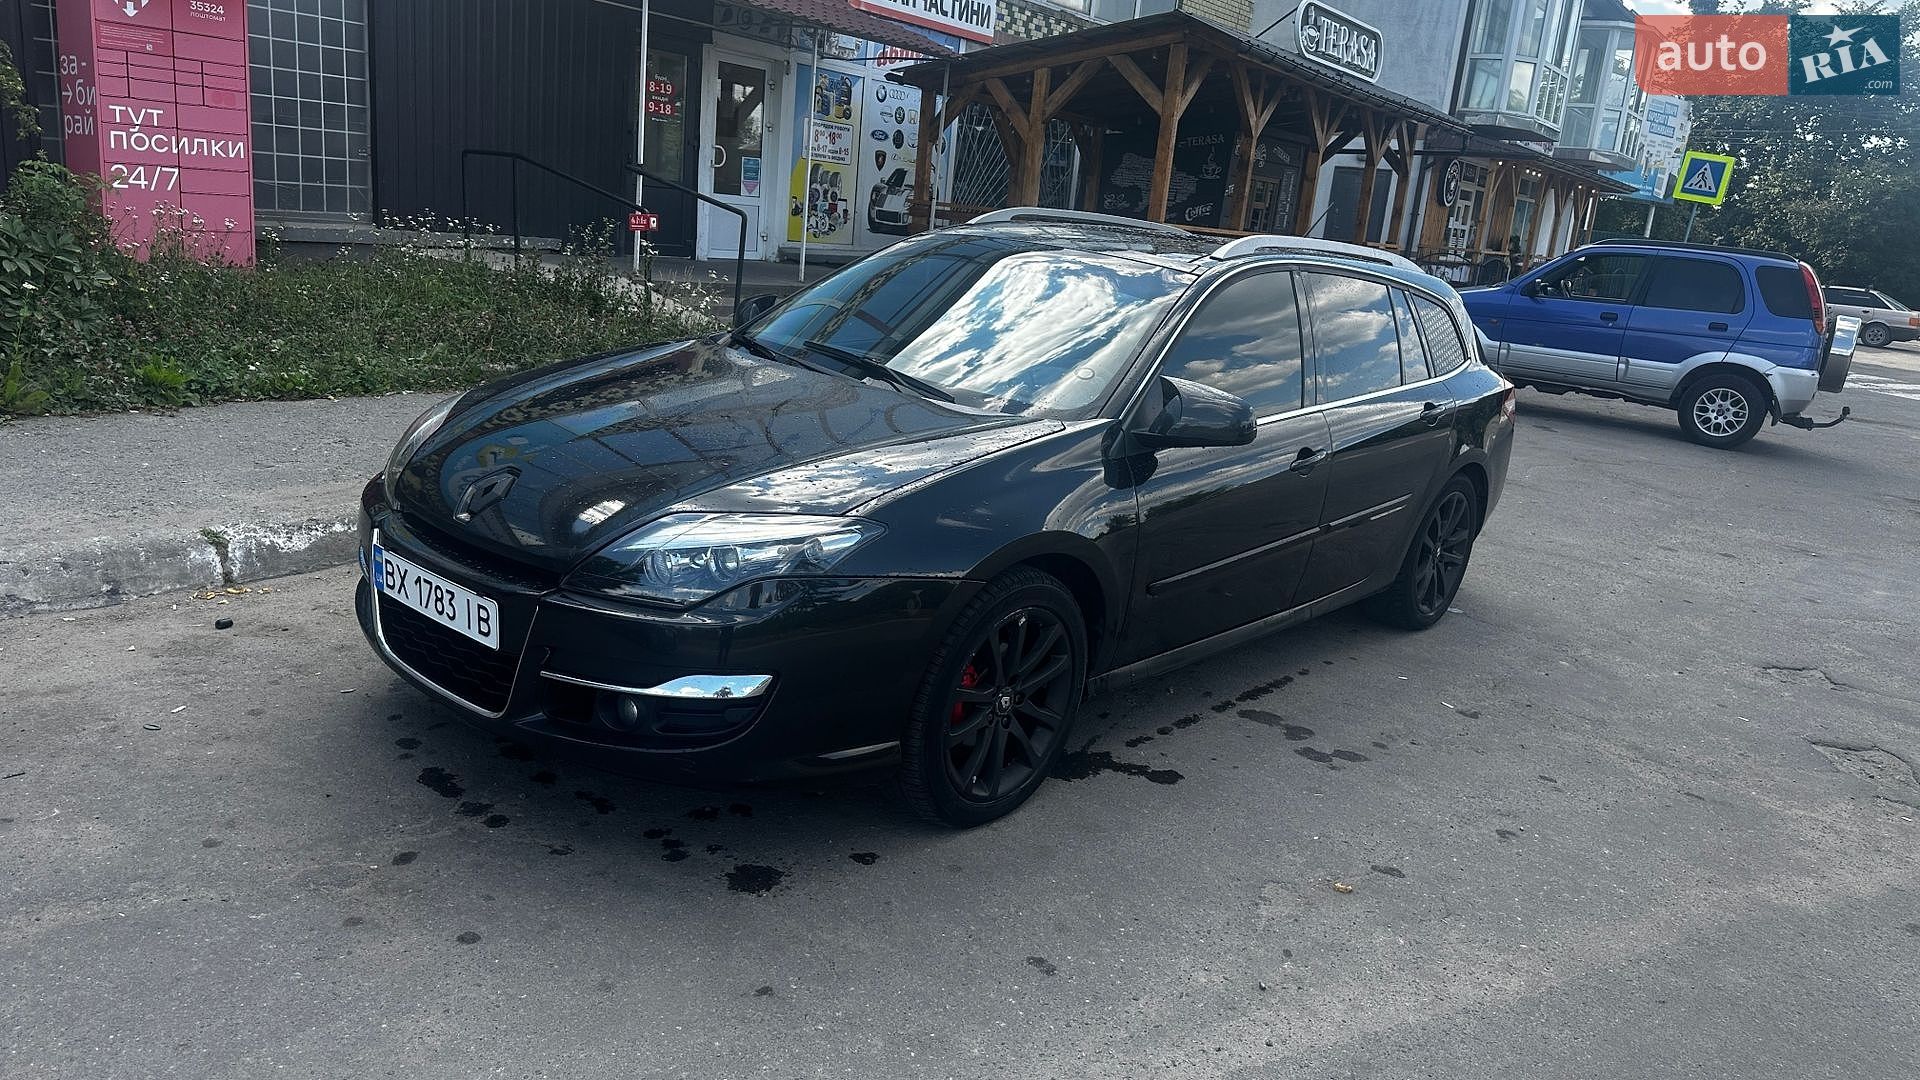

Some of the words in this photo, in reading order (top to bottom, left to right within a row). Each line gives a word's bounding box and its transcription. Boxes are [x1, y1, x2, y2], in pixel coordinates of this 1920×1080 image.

[190, 1, 225, 15] 35324
[1318, 16, 1376, 72] TERASA
[649, 81, 672, 95] 8-19
[648, 101, 672, 115] 9-18
[64, 108, 94, 139] рай
[1186, 134, 1225, 146] TERASA
[110, 164, 180, 191] 24/7
[1184, 202, 1214, 222] Coffee
[414, 575, 457, 622] 1783
